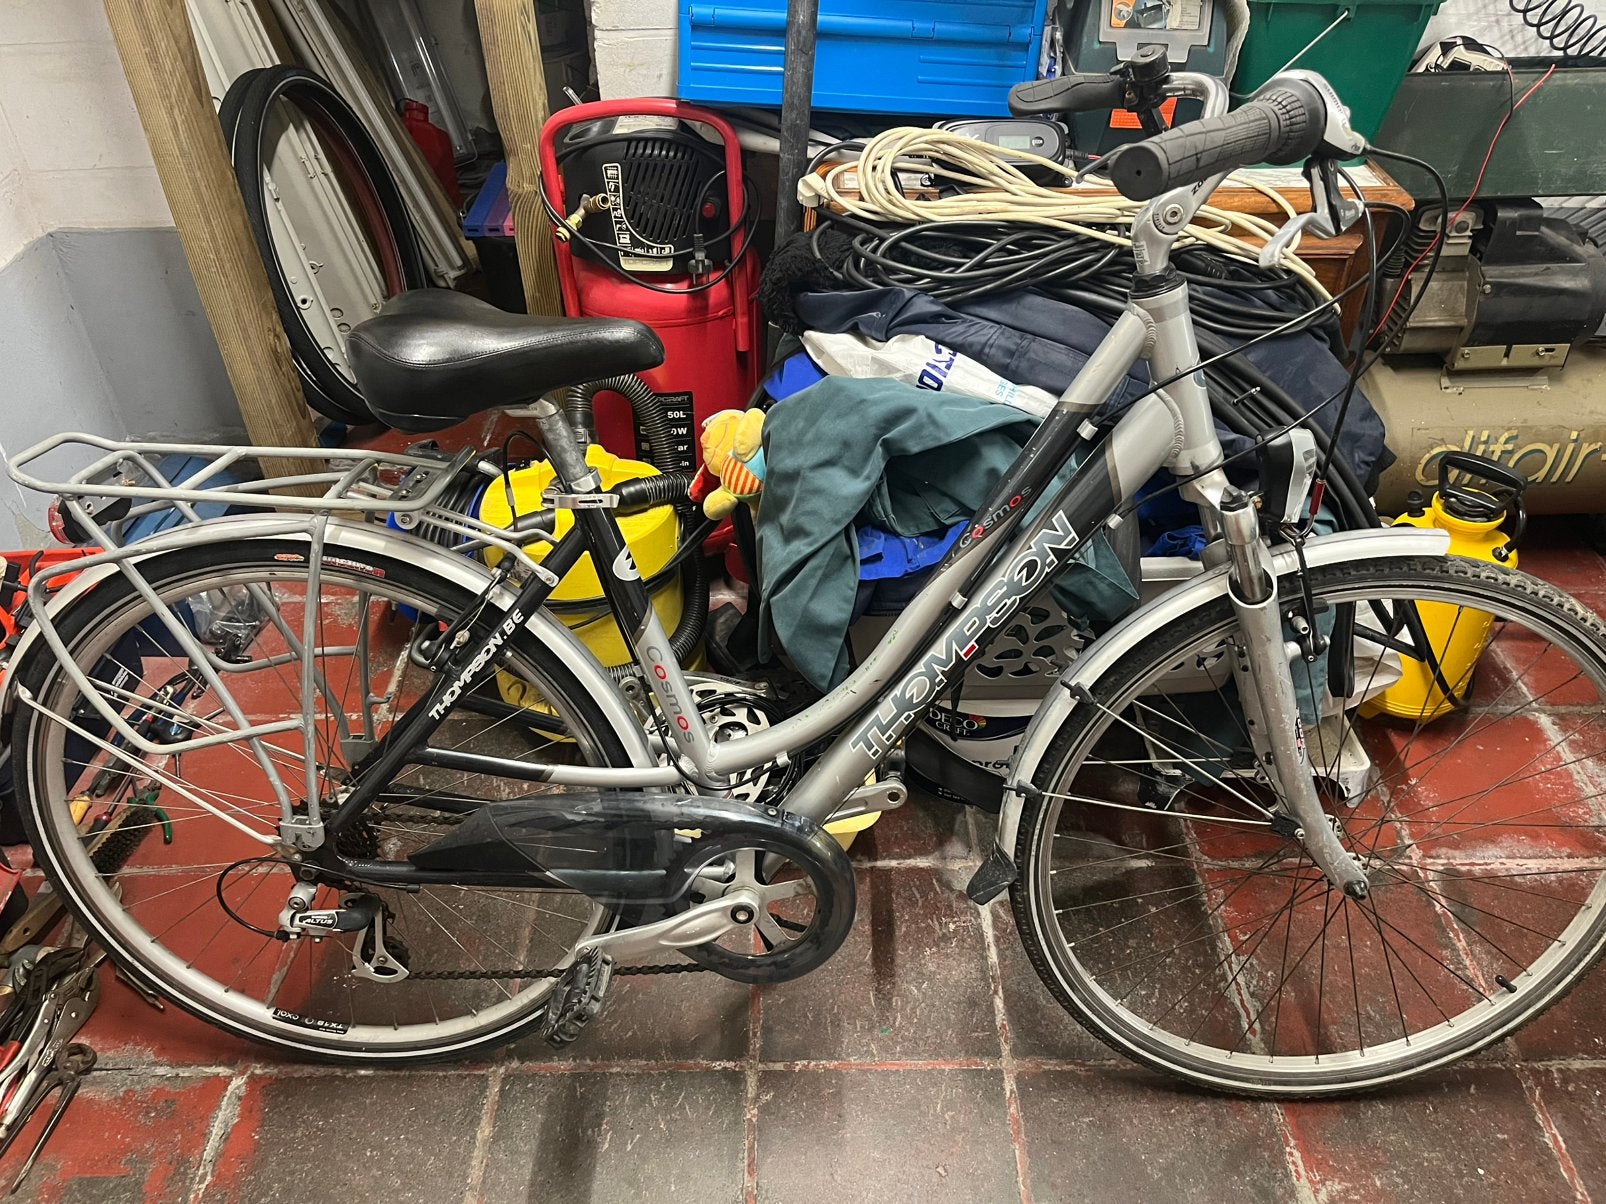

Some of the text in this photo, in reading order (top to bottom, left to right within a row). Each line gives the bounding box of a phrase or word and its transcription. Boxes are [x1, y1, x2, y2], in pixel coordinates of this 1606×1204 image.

[670, 427, 688, 436] 0W
[959, 485, 1032, 548] Cosmos
[428, 608, 525, 720] THOMPSON.BE
[849, 509, 1080, 759] THOMPSON
[646, 645, 695, 744] Cosmos
